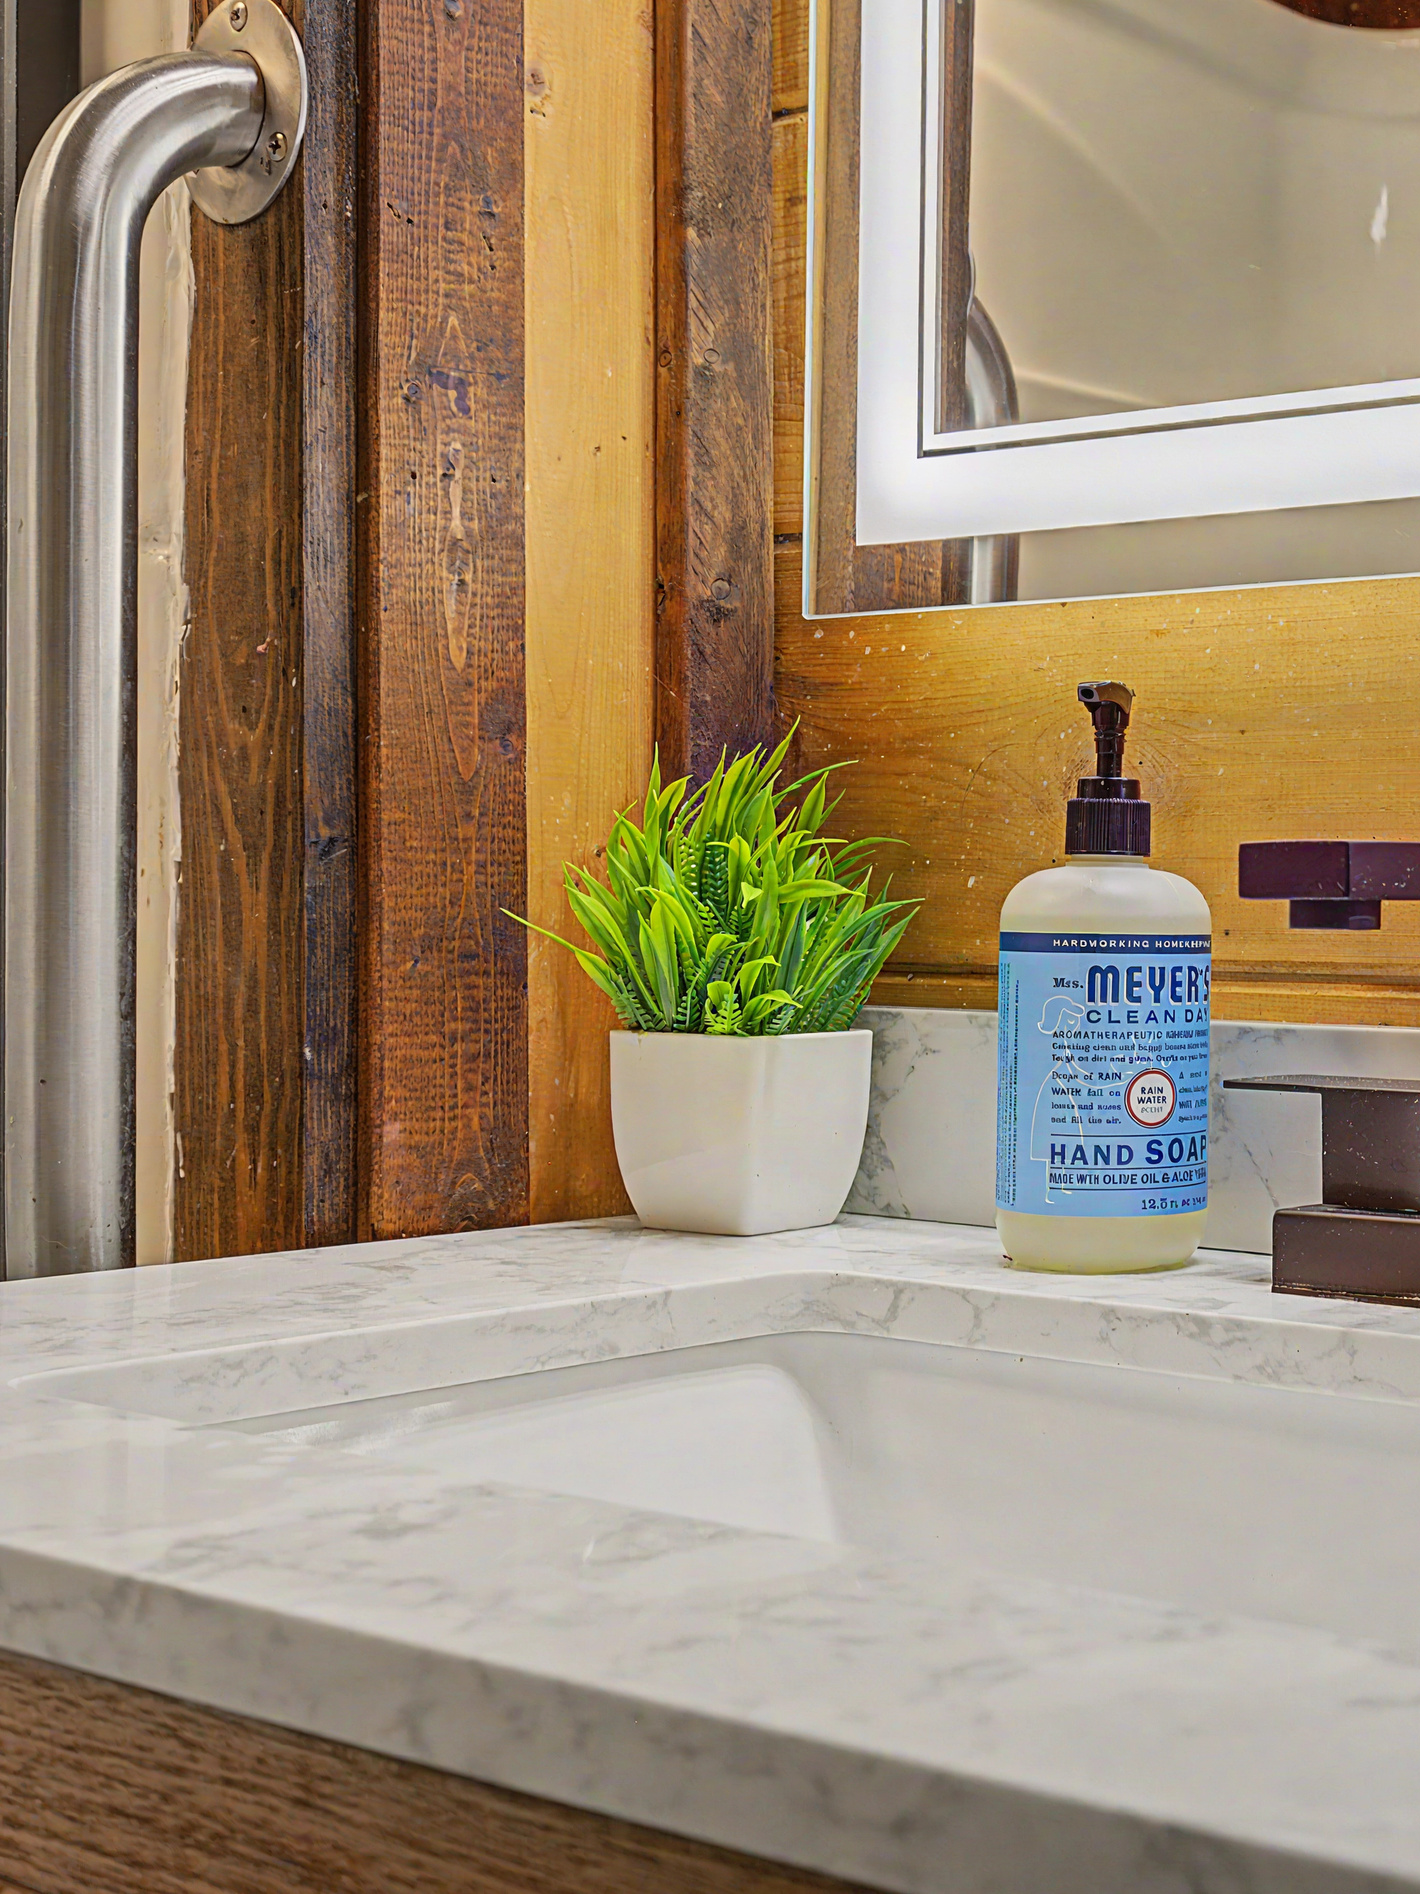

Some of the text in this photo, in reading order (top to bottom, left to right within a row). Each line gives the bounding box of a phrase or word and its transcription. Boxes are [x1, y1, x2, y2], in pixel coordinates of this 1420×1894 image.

[1085, 964, 1209, 1006] MEYER'S
[1086, 1007, 1208, 1024] CLEAN DAY
[1052, 1030, 1163, 1040] AROMATHERAPEUTIC
[1098, 1072, 1122, 1081] RAIN
[1051, 1087, 1082, 1097] WATER
[1140, 1086, 1164, 1095] RAIN
[1137, 1096, 1167, 1104] WATER
[1050, 1135, 1207, 1166] HAND SOAP
[1049, 1172, 1075, 1184] MADE
[1076, 1173, 1100, 1185] WITH
[1102, 1173, 1138, 1185] OLIVE
[1141, 1173, 1160, 1184] OIL
[1171, 1169, 1194, 1183] ALOE
